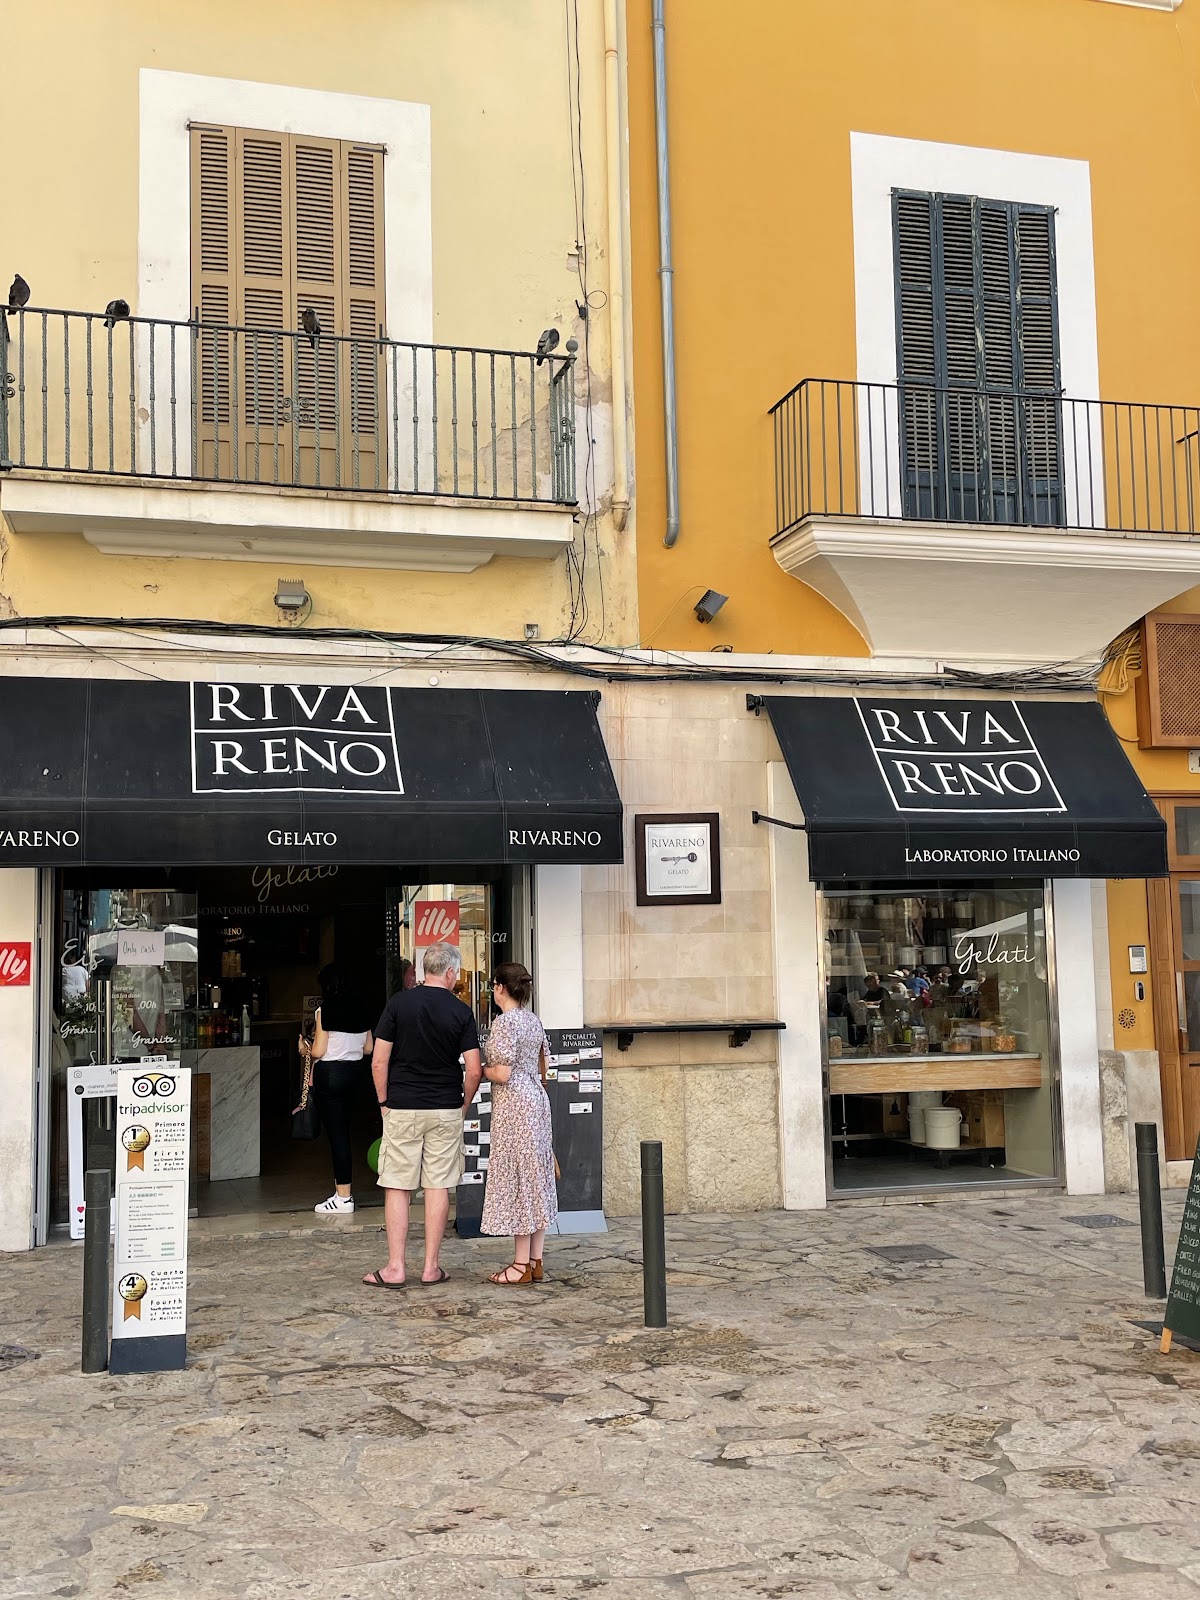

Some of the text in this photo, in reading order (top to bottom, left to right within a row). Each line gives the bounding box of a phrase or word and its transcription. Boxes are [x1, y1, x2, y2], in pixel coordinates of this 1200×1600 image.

[207, 684, 378, 724] RIVA
[871, 708, 1020, 745] RIVA
[210, 737, 387, 776] RENO
[891, 760, 1042, 796] RENO
[508, 830, 602, 846] RIVARENO
[651, 838, 705, 848] RIVARENO
[417, 907, 457, 942] illy
[60, 938, 105, 971] Eis
[122, 941, 137, 957] Only
[954, 931, 1036, 975] Gelati
[131, 1031, 176, 1048] Granite
[562, 1032, 597, 1041] SPECIALITÀ
[563, 1040, 596, 1048] RIVARENO
[119, 1102, 185, 1117] tripadvisor
[151, 1298, 183, 1306] Fourth
